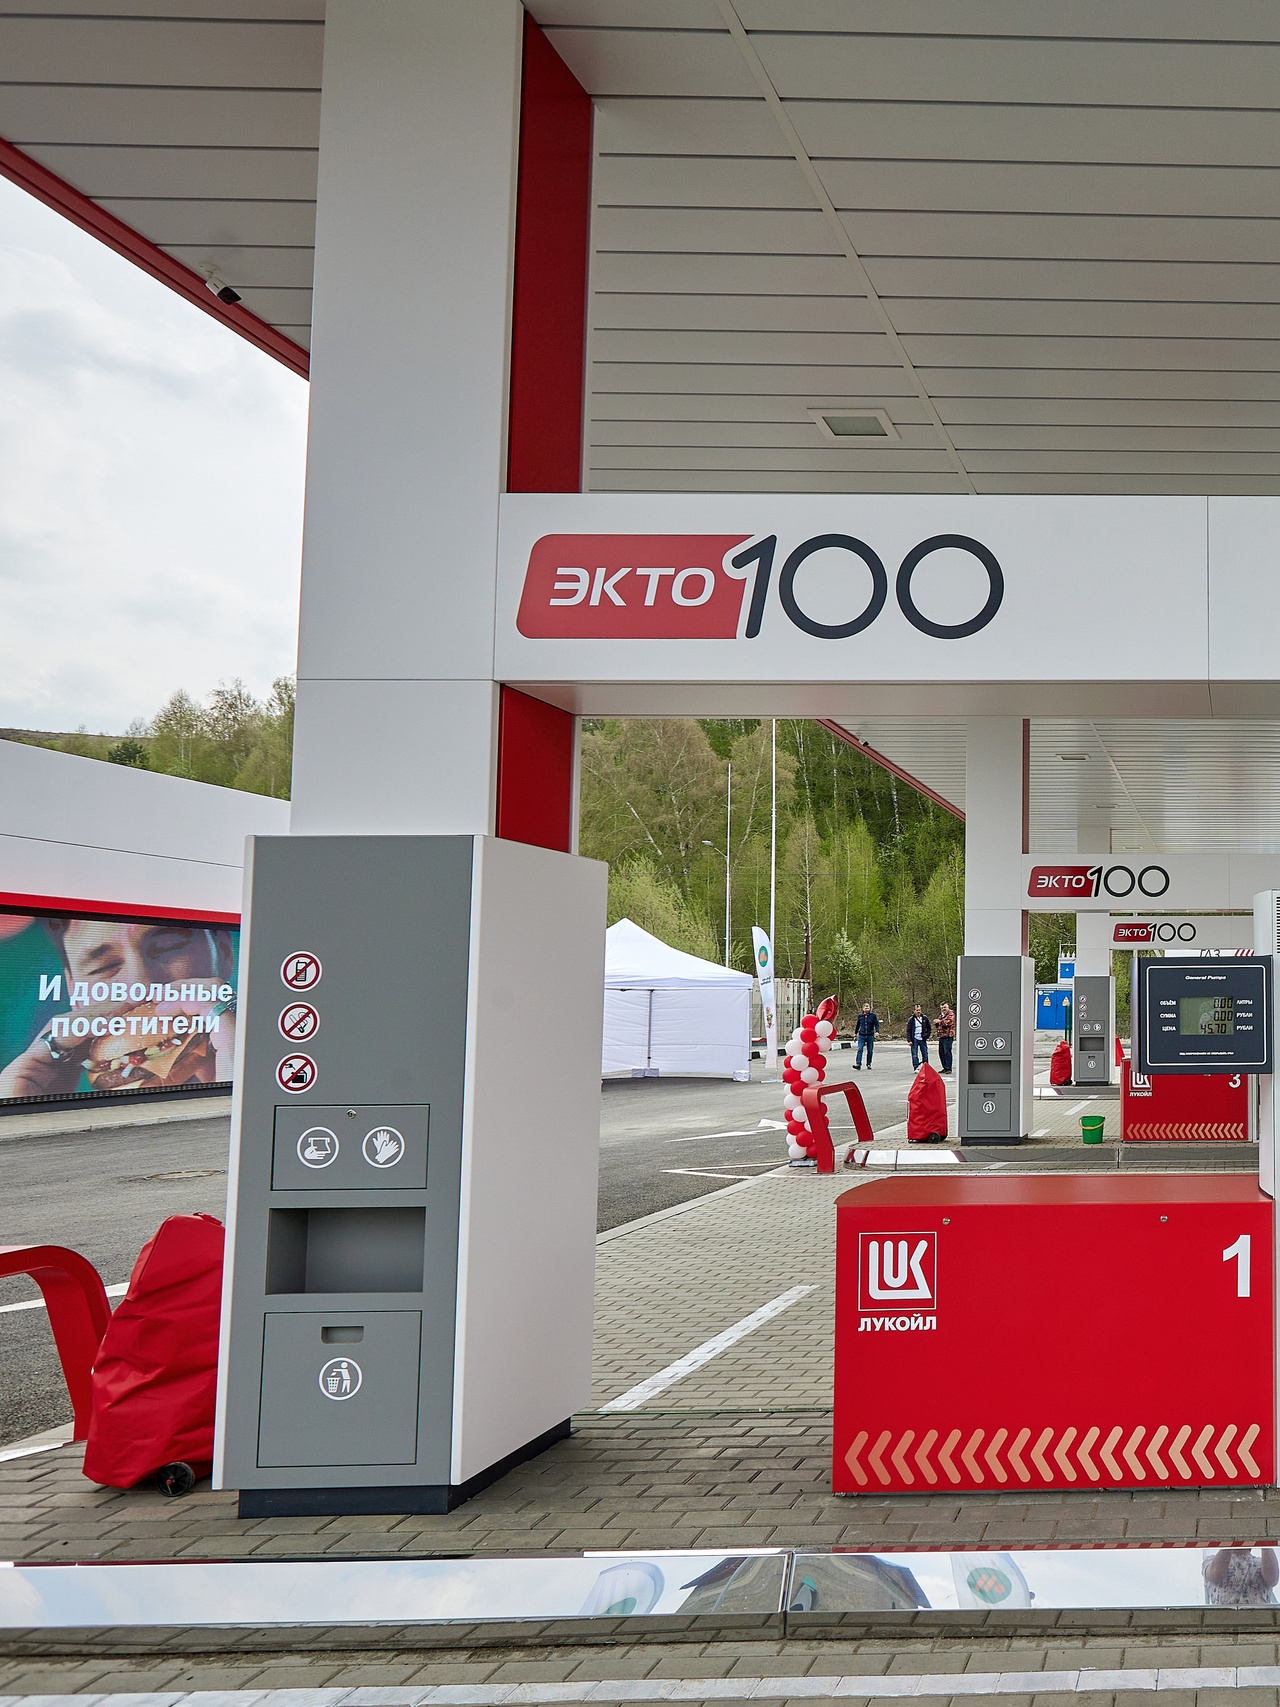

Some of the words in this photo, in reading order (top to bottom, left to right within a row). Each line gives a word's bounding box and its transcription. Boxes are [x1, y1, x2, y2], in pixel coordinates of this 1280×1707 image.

[548, 566, 716, 607] ЭКТО
[730, 533, 1005, 640] 100
[1036, 875, 1086, 888] ЭКТО
[1088, 865, 1171, 898] 100
[1117, 928, 1147, 937] ЭКТО
[1148, 922, 1197, 942] 100
[38, 974, 62, 1001] И
[69, 981, 233, 1006] довольные
[51, 1015, 221, 1038] посетители
[1228, 1074, 1241, 1088] 3
[1221, 1234, 1251, 1298] 1
[857, 1313, 937, 1332] ЛУКОЙЛ
